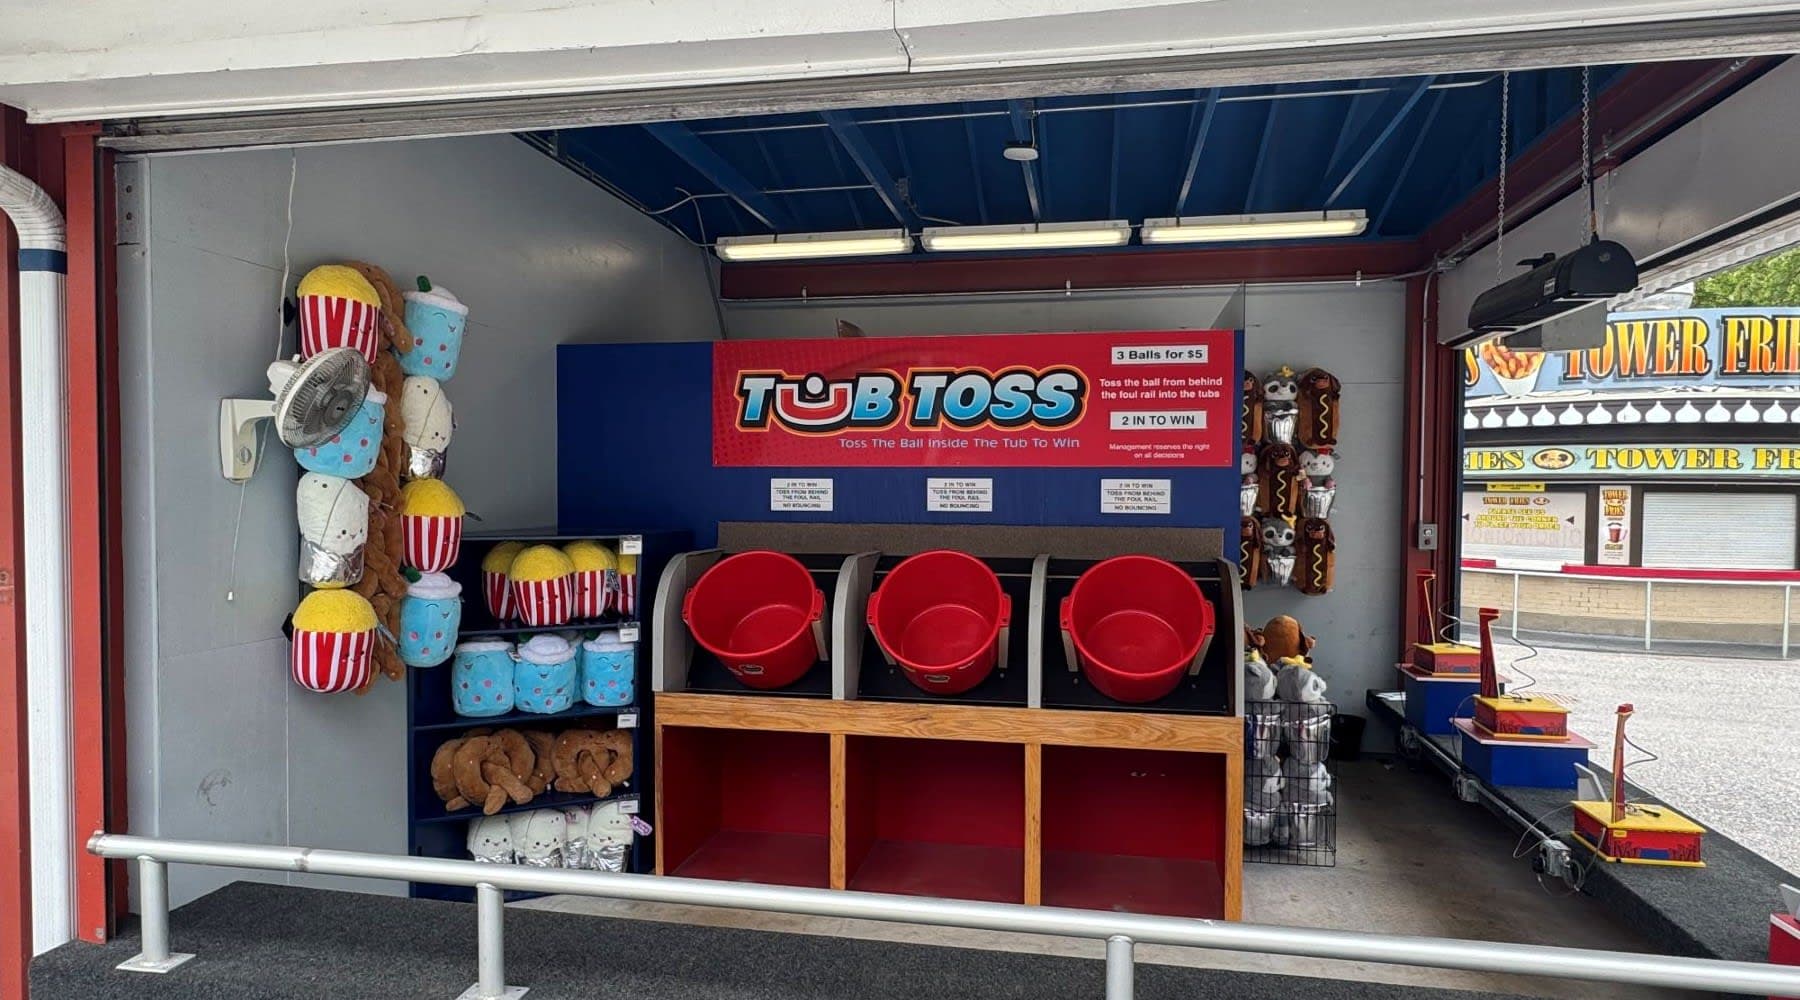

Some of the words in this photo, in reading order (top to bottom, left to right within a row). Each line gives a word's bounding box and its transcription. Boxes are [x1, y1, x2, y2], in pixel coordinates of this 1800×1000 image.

[1116, 351, 1125, 360] 3
[1129, 350, 1161, 360] Balls
[1165, 350, 1184, 359] for
[1187, 349, 1203, 359] $5
[1099, 378, 1122, 387] Toss
[1124, 378, 1140, 387] the
[1142, 378, 1160, 387] ball
[1162, 378, 1186, 386] from
[1188, 377, 1223, 386] behind
[1101, 391, 1117, 399] the
[1119, 390, 1138, 399] foul
[1140, 390, 1156, 399] rail
[1158, 390, 1177, 398] into
[1180, 390, 1196, 398] the
[1198, 390, 1220, 398] tubs
[740, 372, 900, 430] TUB
[910, 372, 1081, 424] TOSS
[1121, 416, 1129, 426] 2
[1132, 415, 1145, 425] IN
[1149, 415, 1166, 425] TO
[1169, 415, 1195, 425] WIN
[839, 437, 867, 449] Toss
[871, 437, 896, 449] The
[900, 437, 924, 449] Ball
[928, 437, 969, 449] Inside
[973, 437, 999, 449] The
[1002, 437, 1028, 449] Tub
[1031, 437, 1048, 449] To
[1052, 437, 1081, 449] Win
[1462, 448, 1525, 470] IES
[1585, 447, 1744, 470] TOWER
